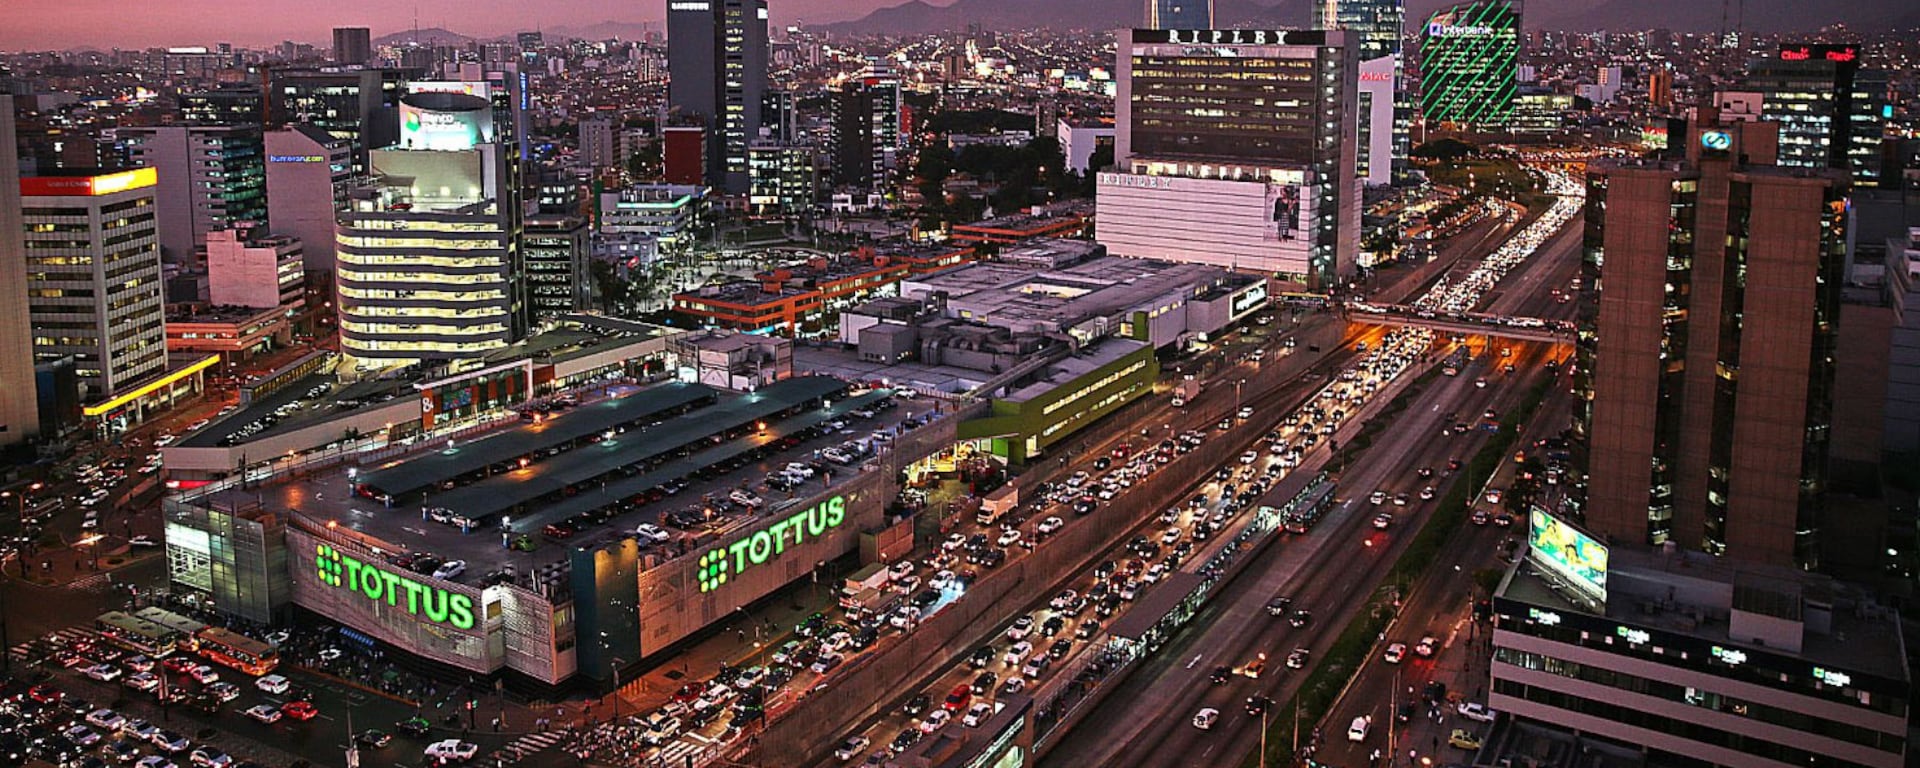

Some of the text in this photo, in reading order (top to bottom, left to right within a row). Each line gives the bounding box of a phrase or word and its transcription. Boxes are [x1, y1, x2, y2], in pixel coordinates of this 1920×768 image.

[1168, 29, 1288, 45] RIPLEY
[1103, 175, 1171, 189] RIPLEY
[729, 495, 845, 575] TOTTUS
[342, 555, 474, 629] TOTTUS
